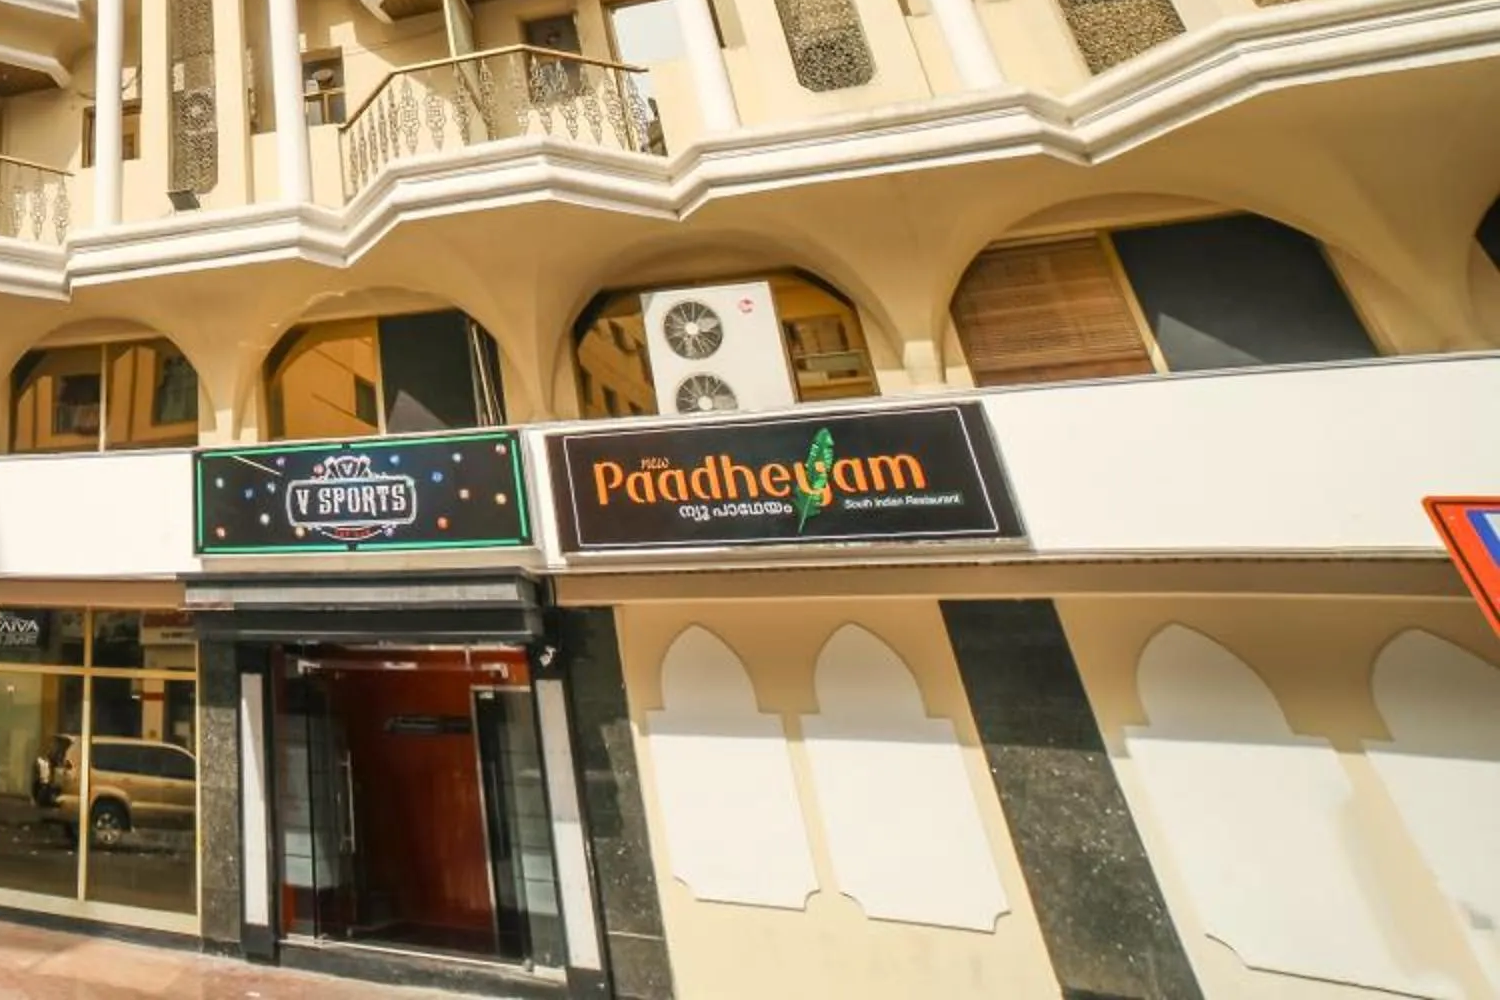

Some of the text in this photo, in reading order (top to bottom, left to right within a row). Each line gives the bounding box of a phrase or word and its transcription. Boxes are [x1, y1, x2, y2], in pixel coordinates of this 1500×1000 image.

[296, 484, 407, 517] V SPORTS
[593, 452, 927, 508] Paadheyam
